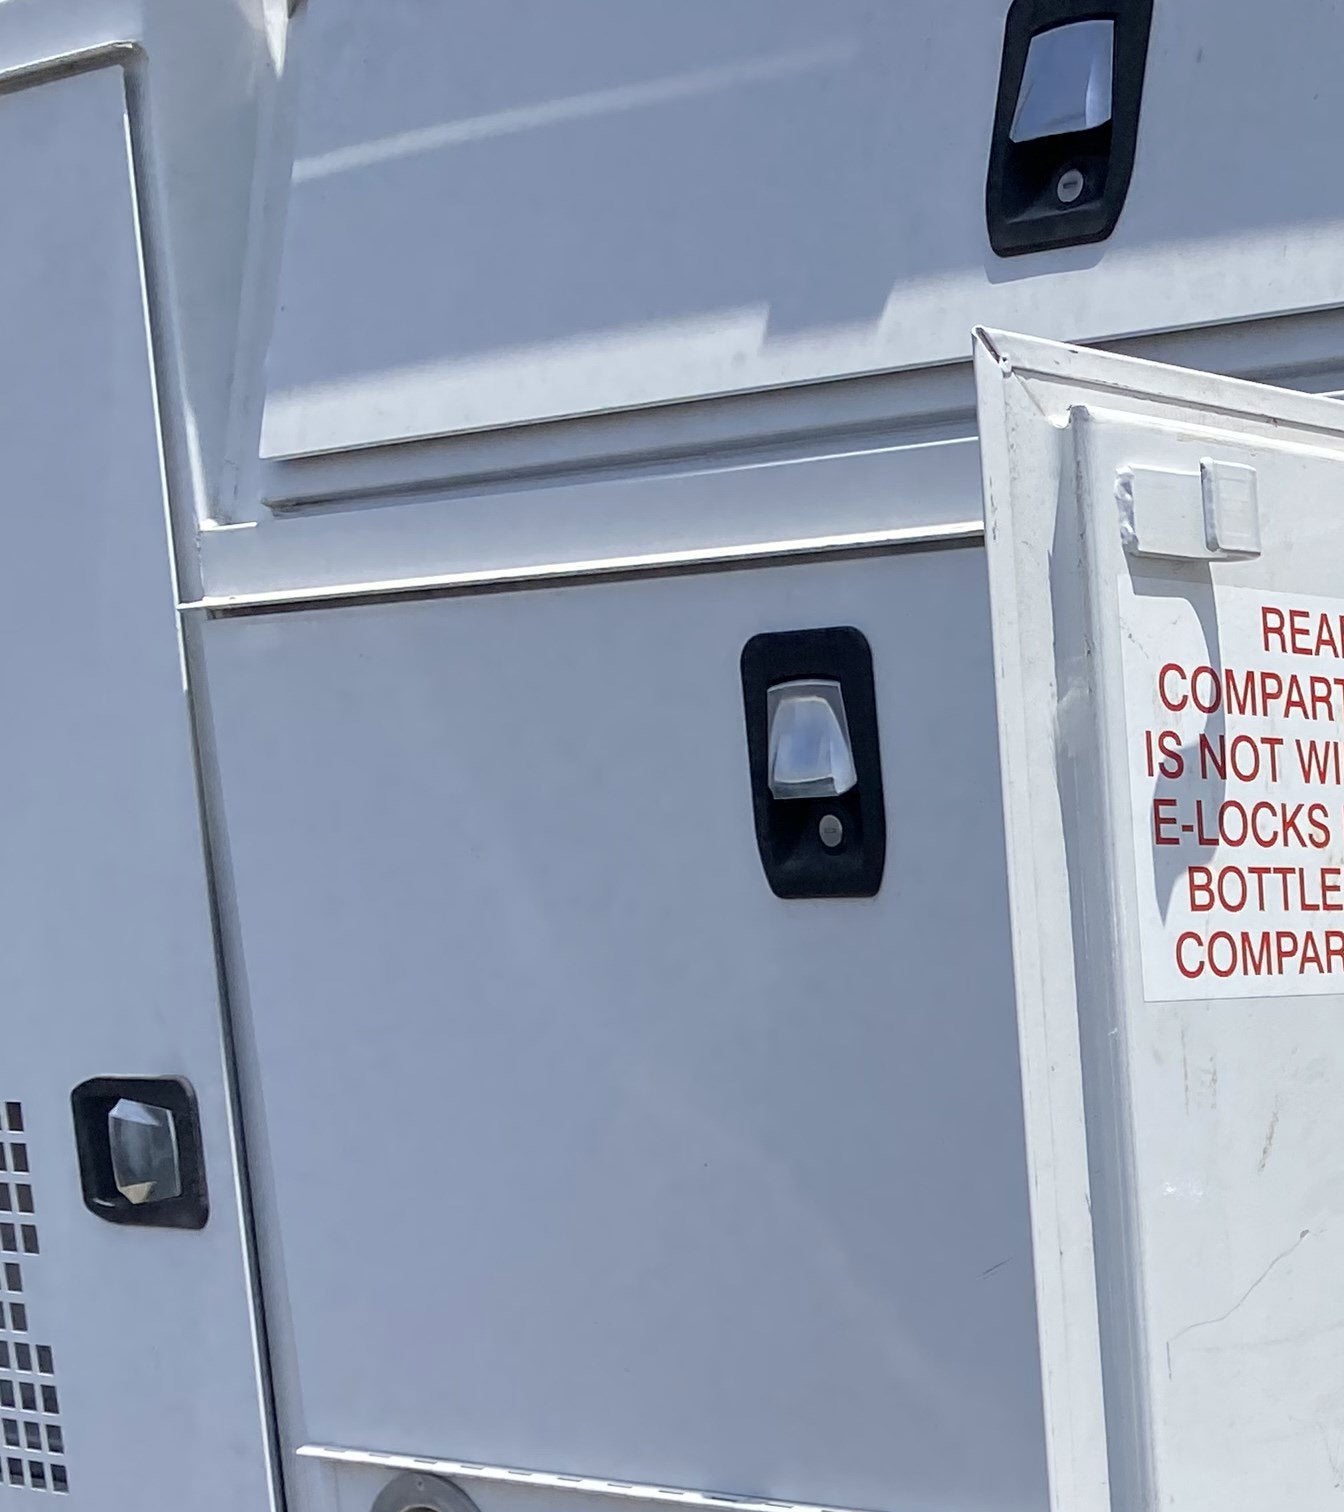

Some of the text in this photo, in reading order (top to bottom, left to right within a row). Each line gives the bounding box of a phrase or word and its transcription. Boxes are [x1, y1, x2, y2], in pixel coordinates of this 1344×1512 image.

[1146, 731, 1183, 777] IS
[1201, 735, 1282, 782] NOT
[1153, 799, 1329, 848] E-LOCKS
